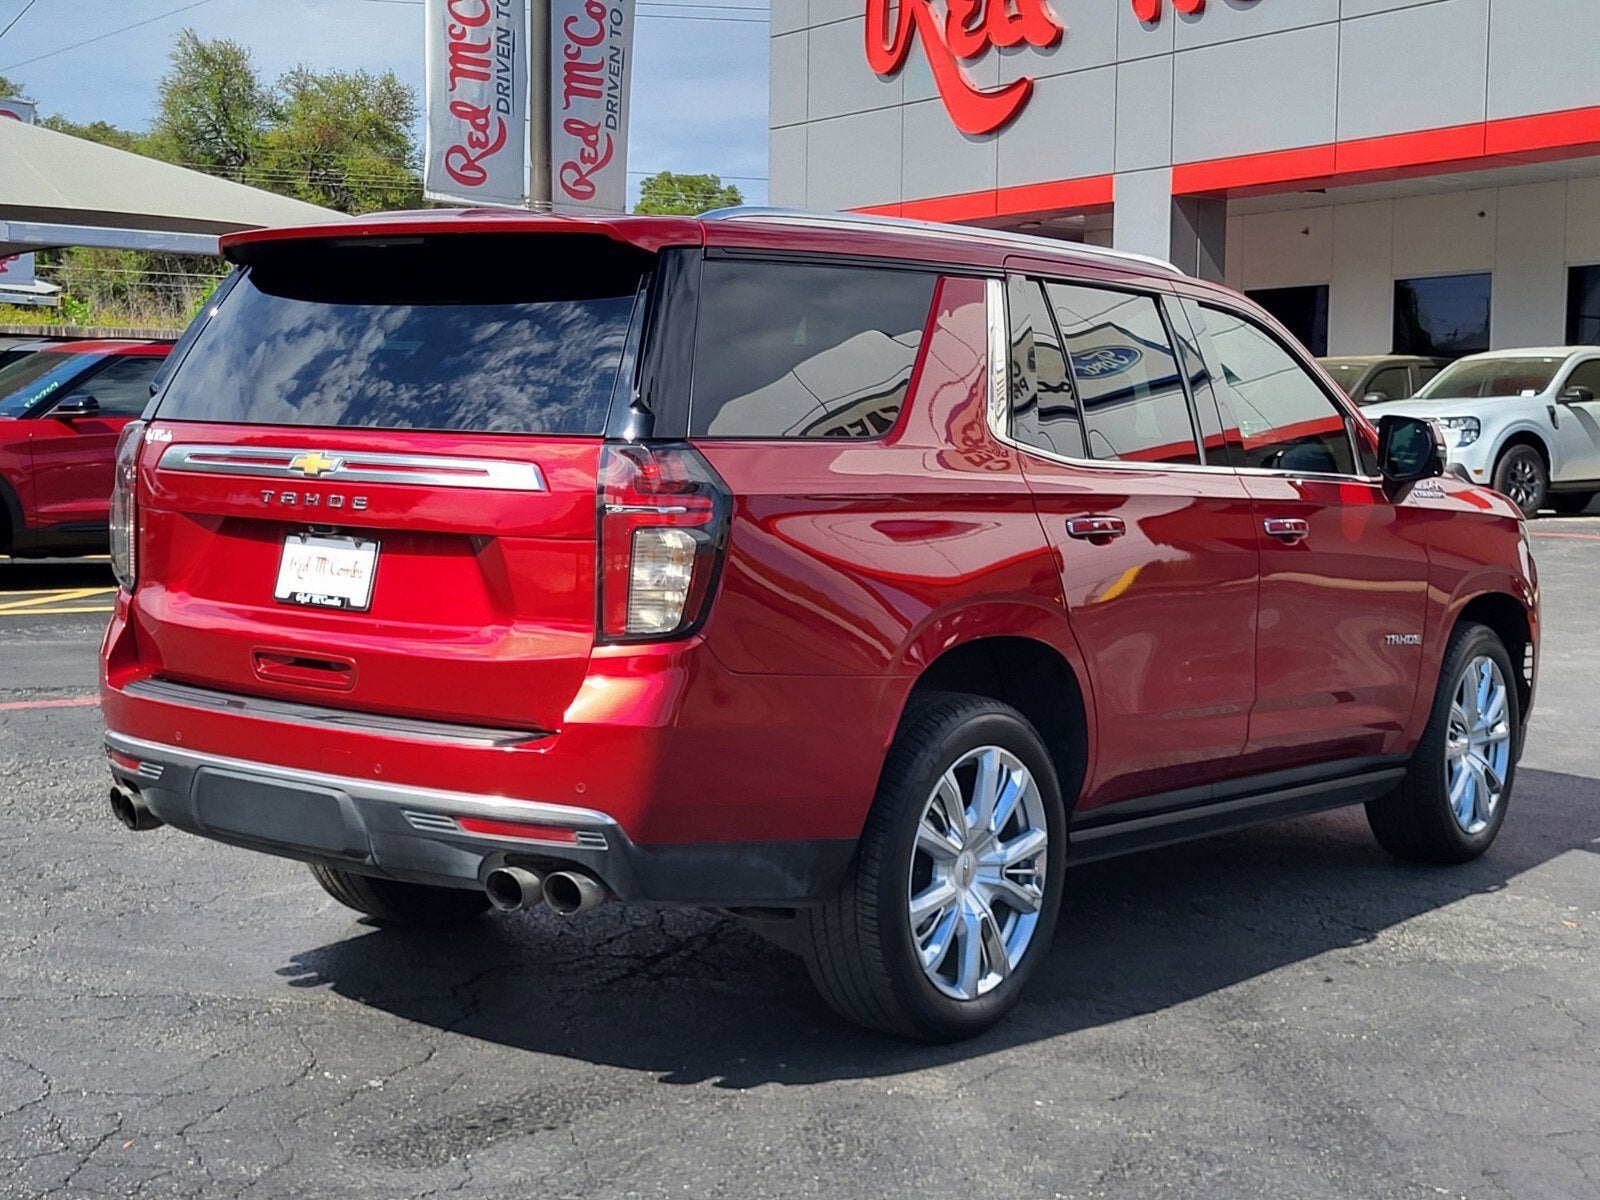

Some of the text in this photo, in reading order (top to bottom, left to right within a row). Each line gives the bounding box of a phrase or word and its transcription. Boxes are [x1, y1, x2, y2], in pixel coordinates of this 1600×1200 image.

[496, 26, 511, 115] DRIVEN
[605, 8, 623, 131] DRIVEN TO
[445, 100, 507, 187] Red
[560, 118, 614, 200] Red
[261, 489, 369, 511] TAHOE
[1384, 634, 1422, 645] TAHOE
